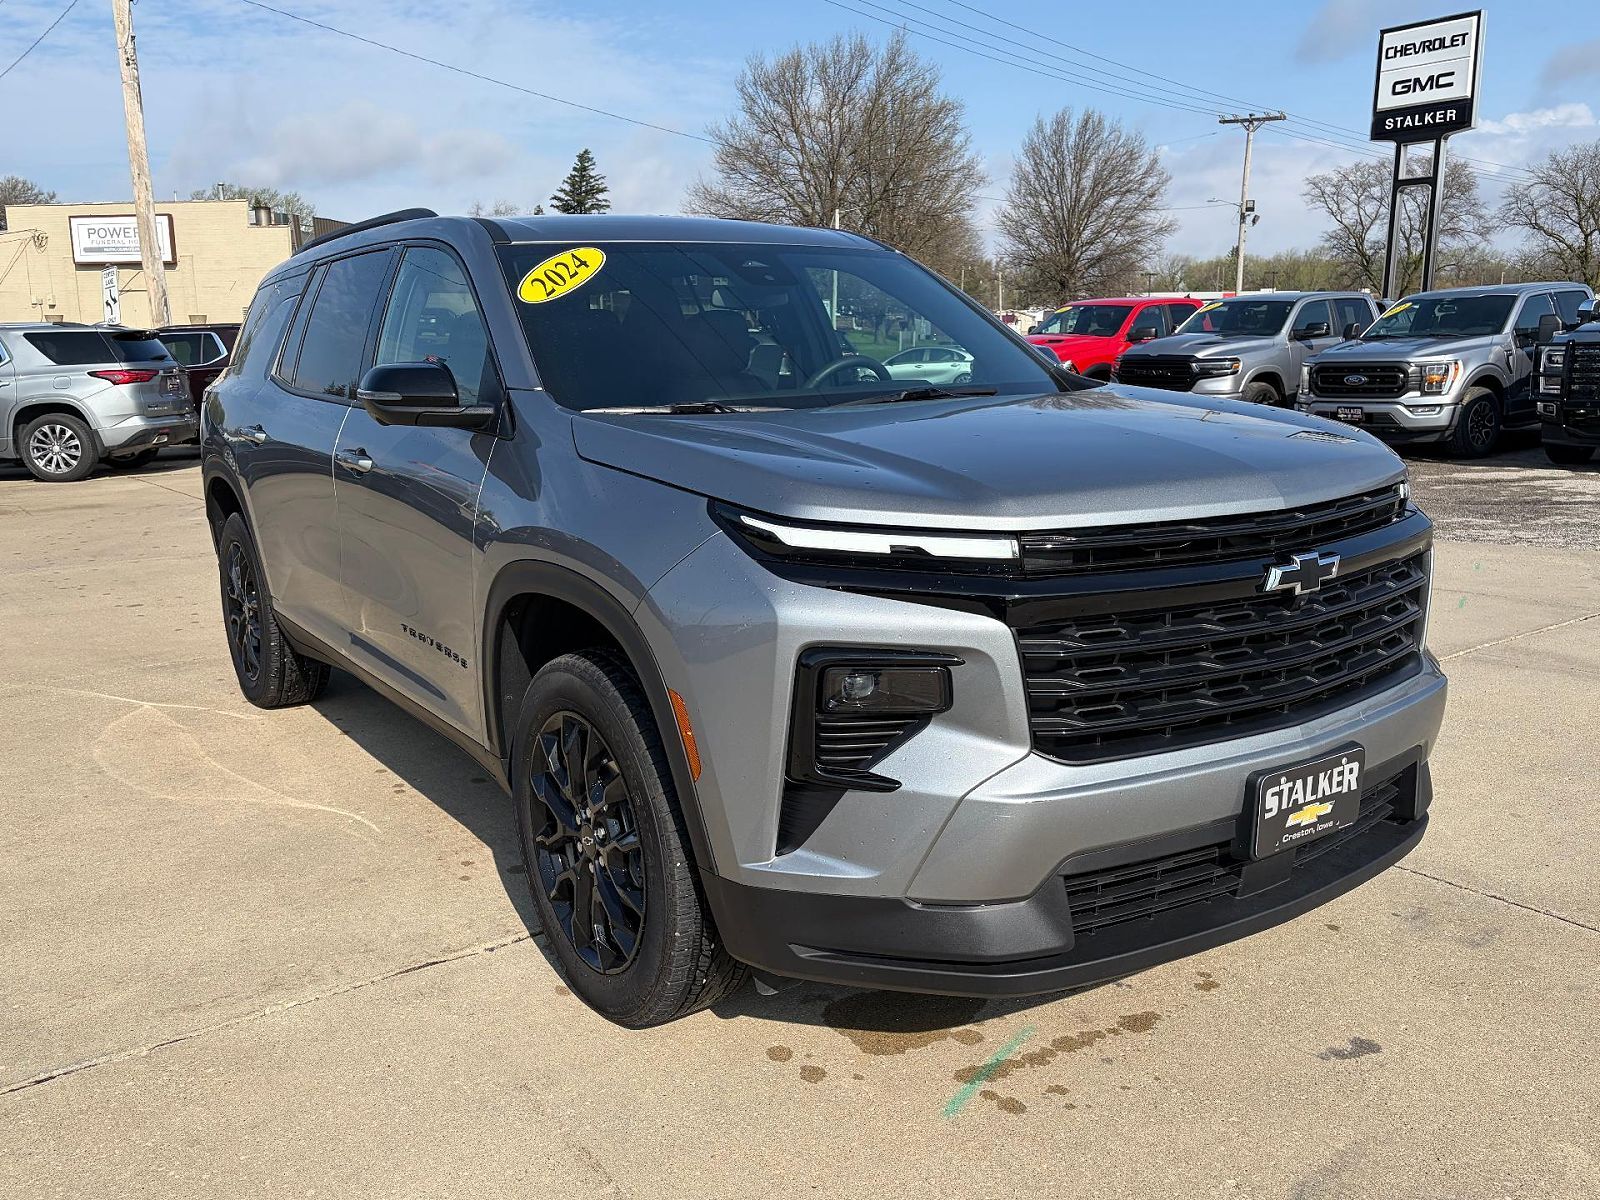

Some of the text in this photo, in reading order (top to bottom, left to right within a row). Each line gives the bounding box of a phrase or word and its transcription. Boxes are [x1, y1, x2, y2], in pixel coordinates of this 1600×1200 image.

[1385, 32, 1469, 60] CHEVROLET
[1391, 71, 1455, 96] GMC
[1384, 109, 1457, 130] STALKER
[87, 227, 139, 239] POWER
[530, 252, 590, 297] 2024
[400, 623, 468, 669] TRAVERSE
[1264, 757, 1360, 819] STALKER
[1282, 820, 1334, 843] Creston, Iowa
